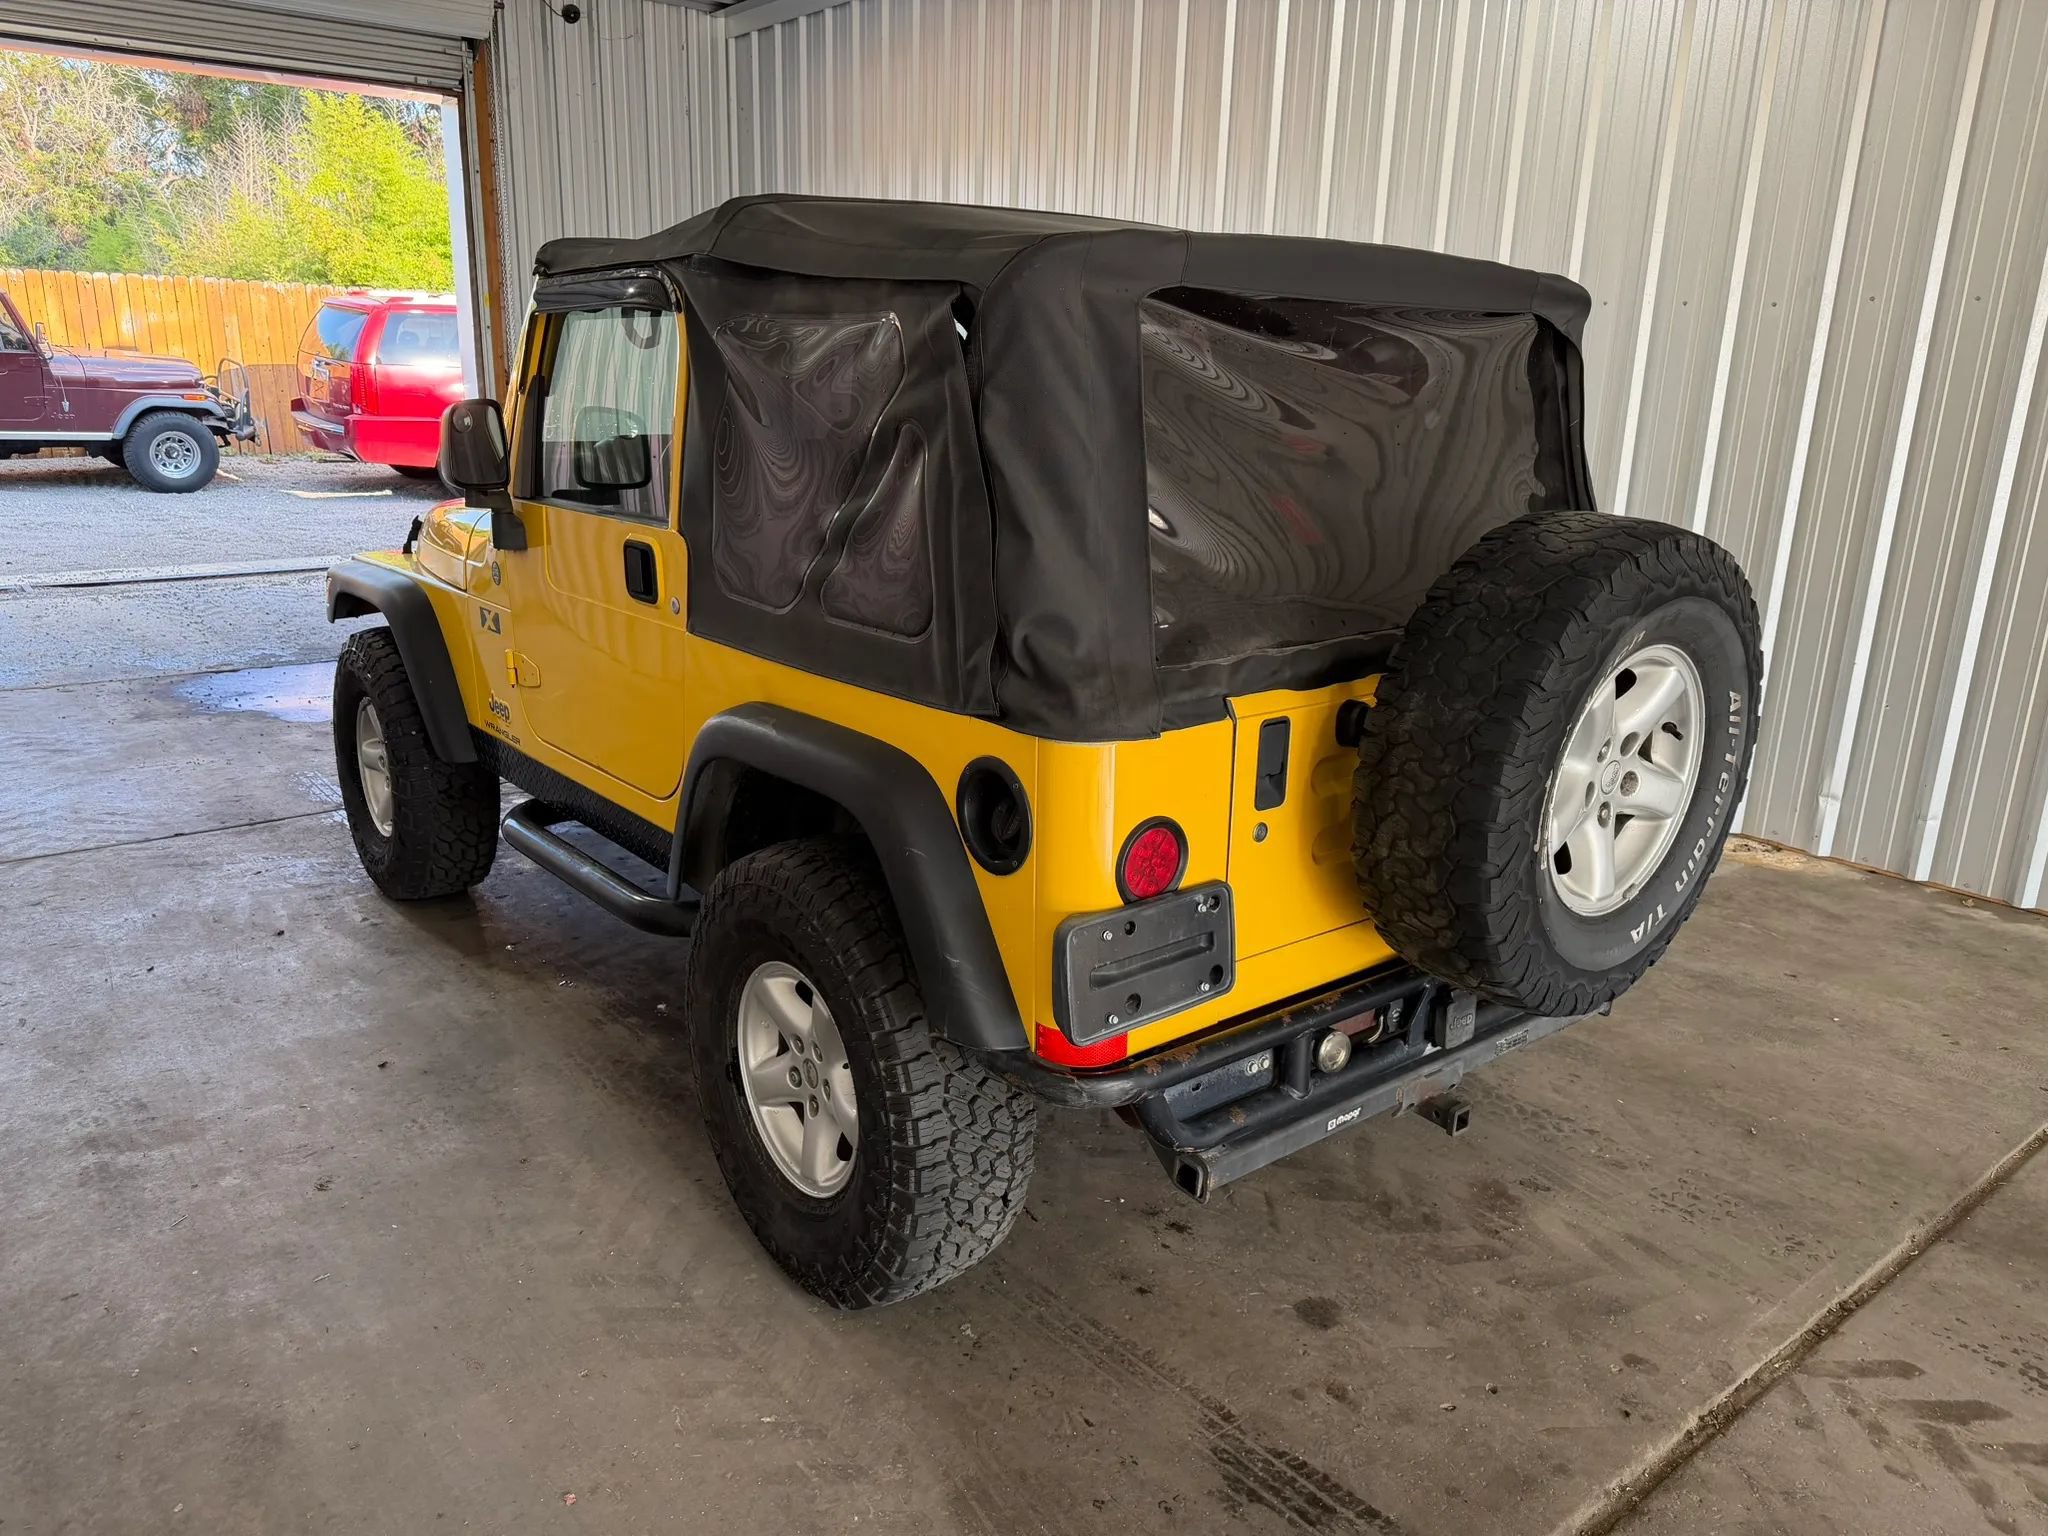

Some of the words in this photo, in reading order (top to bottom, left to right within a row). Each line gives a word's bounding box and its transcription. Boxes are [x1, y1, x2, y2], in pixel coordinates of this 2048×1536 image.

[488, 689, 511, 723] Jeep
[484, 720, 520, 745] WRANGLER
[1674, 690, 1742, 893] All-Terrain
[1630, 903, 1668, 944] T/A
